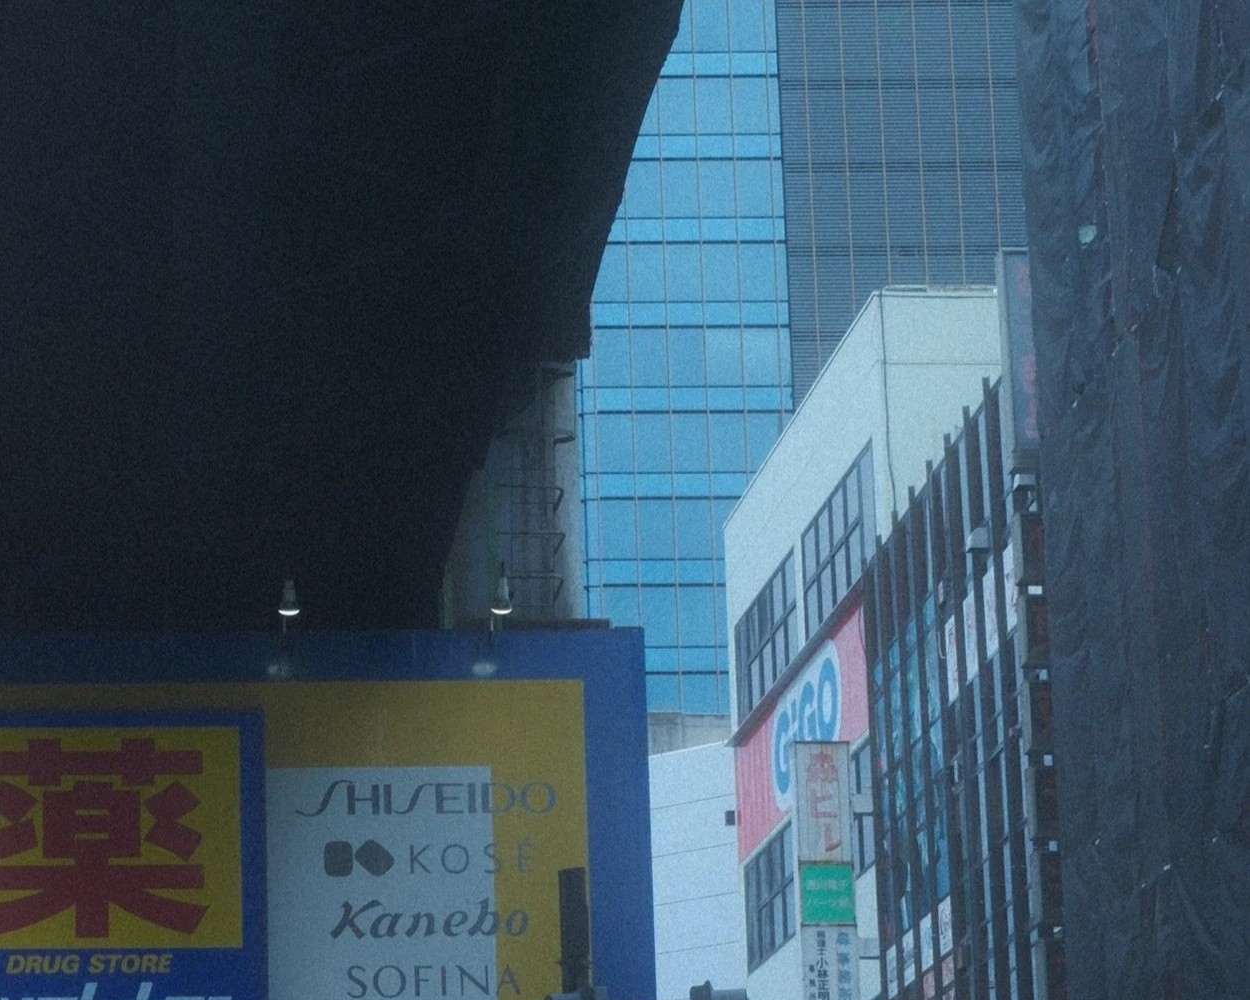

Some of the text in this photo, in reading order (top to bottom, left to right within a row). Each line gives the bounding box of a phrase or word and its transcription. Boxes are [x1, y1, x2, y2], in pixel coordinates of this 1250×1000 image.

[296, 779, 556, 816] SHISEIDO
[410, 837, 536, 874] KOSÉ
[330, 899, 529, 940] Kanebo
[6, 954, 173, 974] DRUG STORE
[347, 965, 521, 1000] SOFINA
